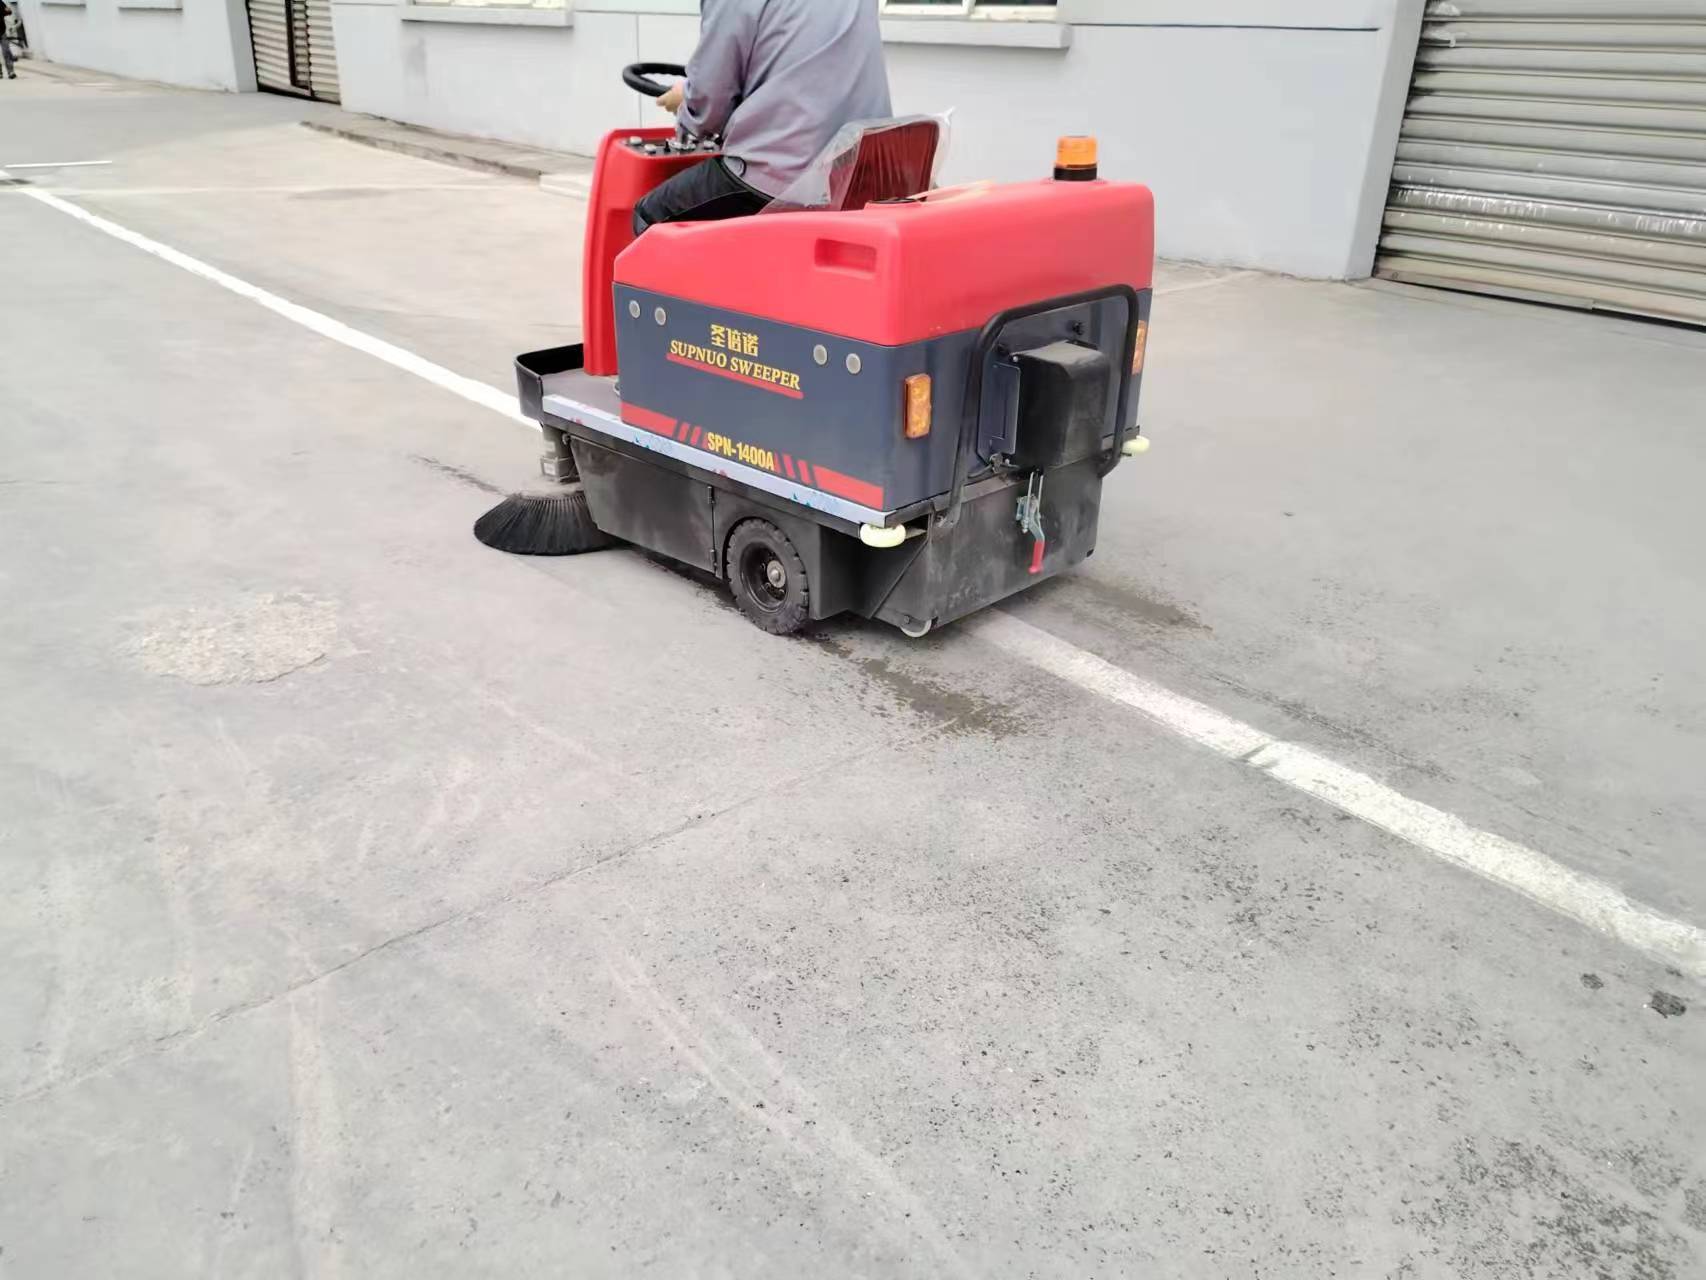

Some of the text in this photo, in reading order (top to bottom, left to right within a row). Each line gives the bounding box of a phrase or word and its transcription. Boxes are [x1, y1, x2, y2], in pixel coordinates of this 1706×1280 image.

[710, 323, 759, 357] 圣倍诺
[670, 340, 800, 390] SUPNUO SWEEPER
[707, 432, 775, 471] SPN-1400A
